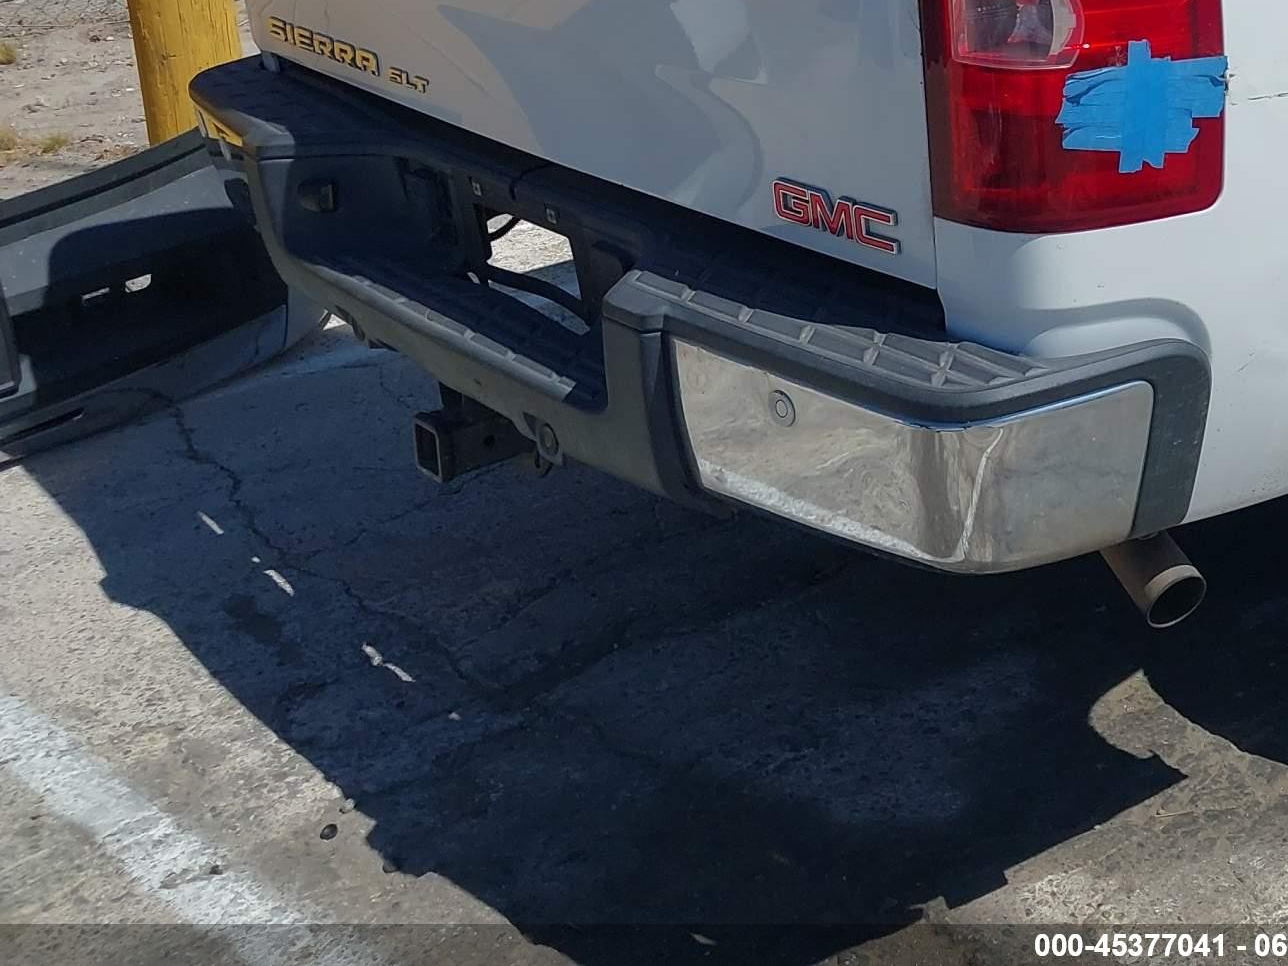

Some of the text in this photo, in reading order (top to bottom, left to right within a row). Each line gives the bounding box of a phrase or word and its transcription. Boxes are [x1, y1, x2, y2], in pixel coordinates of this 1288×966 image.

[267, 16, 430, 94] SIERRA SLT
[772, 177, 901, 255] GMC
